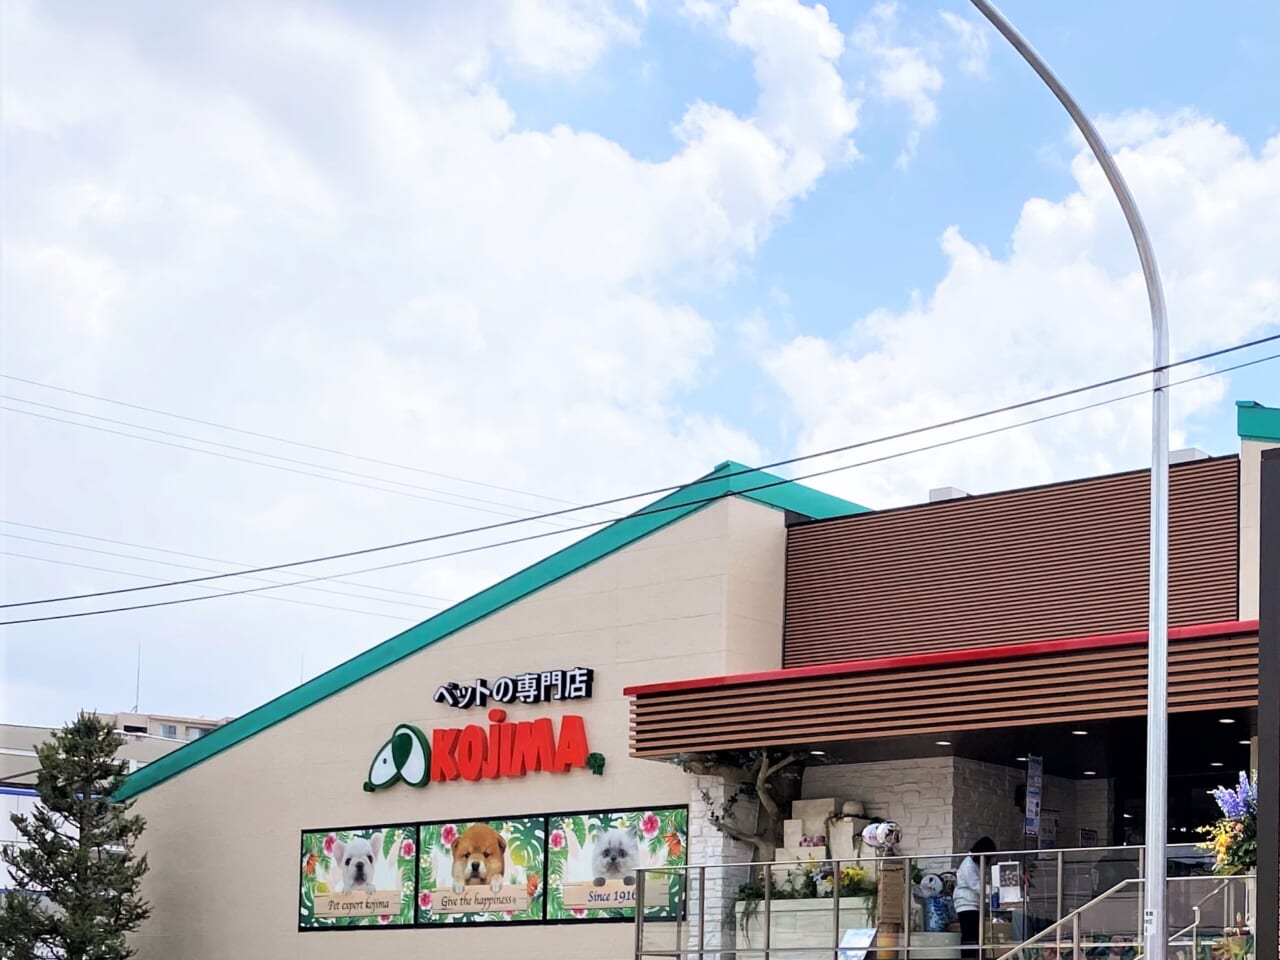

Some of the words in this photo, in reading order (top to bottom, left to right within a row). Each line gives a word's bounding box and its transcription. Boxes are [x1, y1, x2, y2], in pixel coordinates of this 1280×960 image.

[433, 667, 593, 709] ペットの専門店
[441, 895, 458, 907] Give
[460, 892, 472, 906] the
[588, 890, 611, 902] Since
[328, 900, 340, 911] Pet
[341, 900, 364, 915] expert
